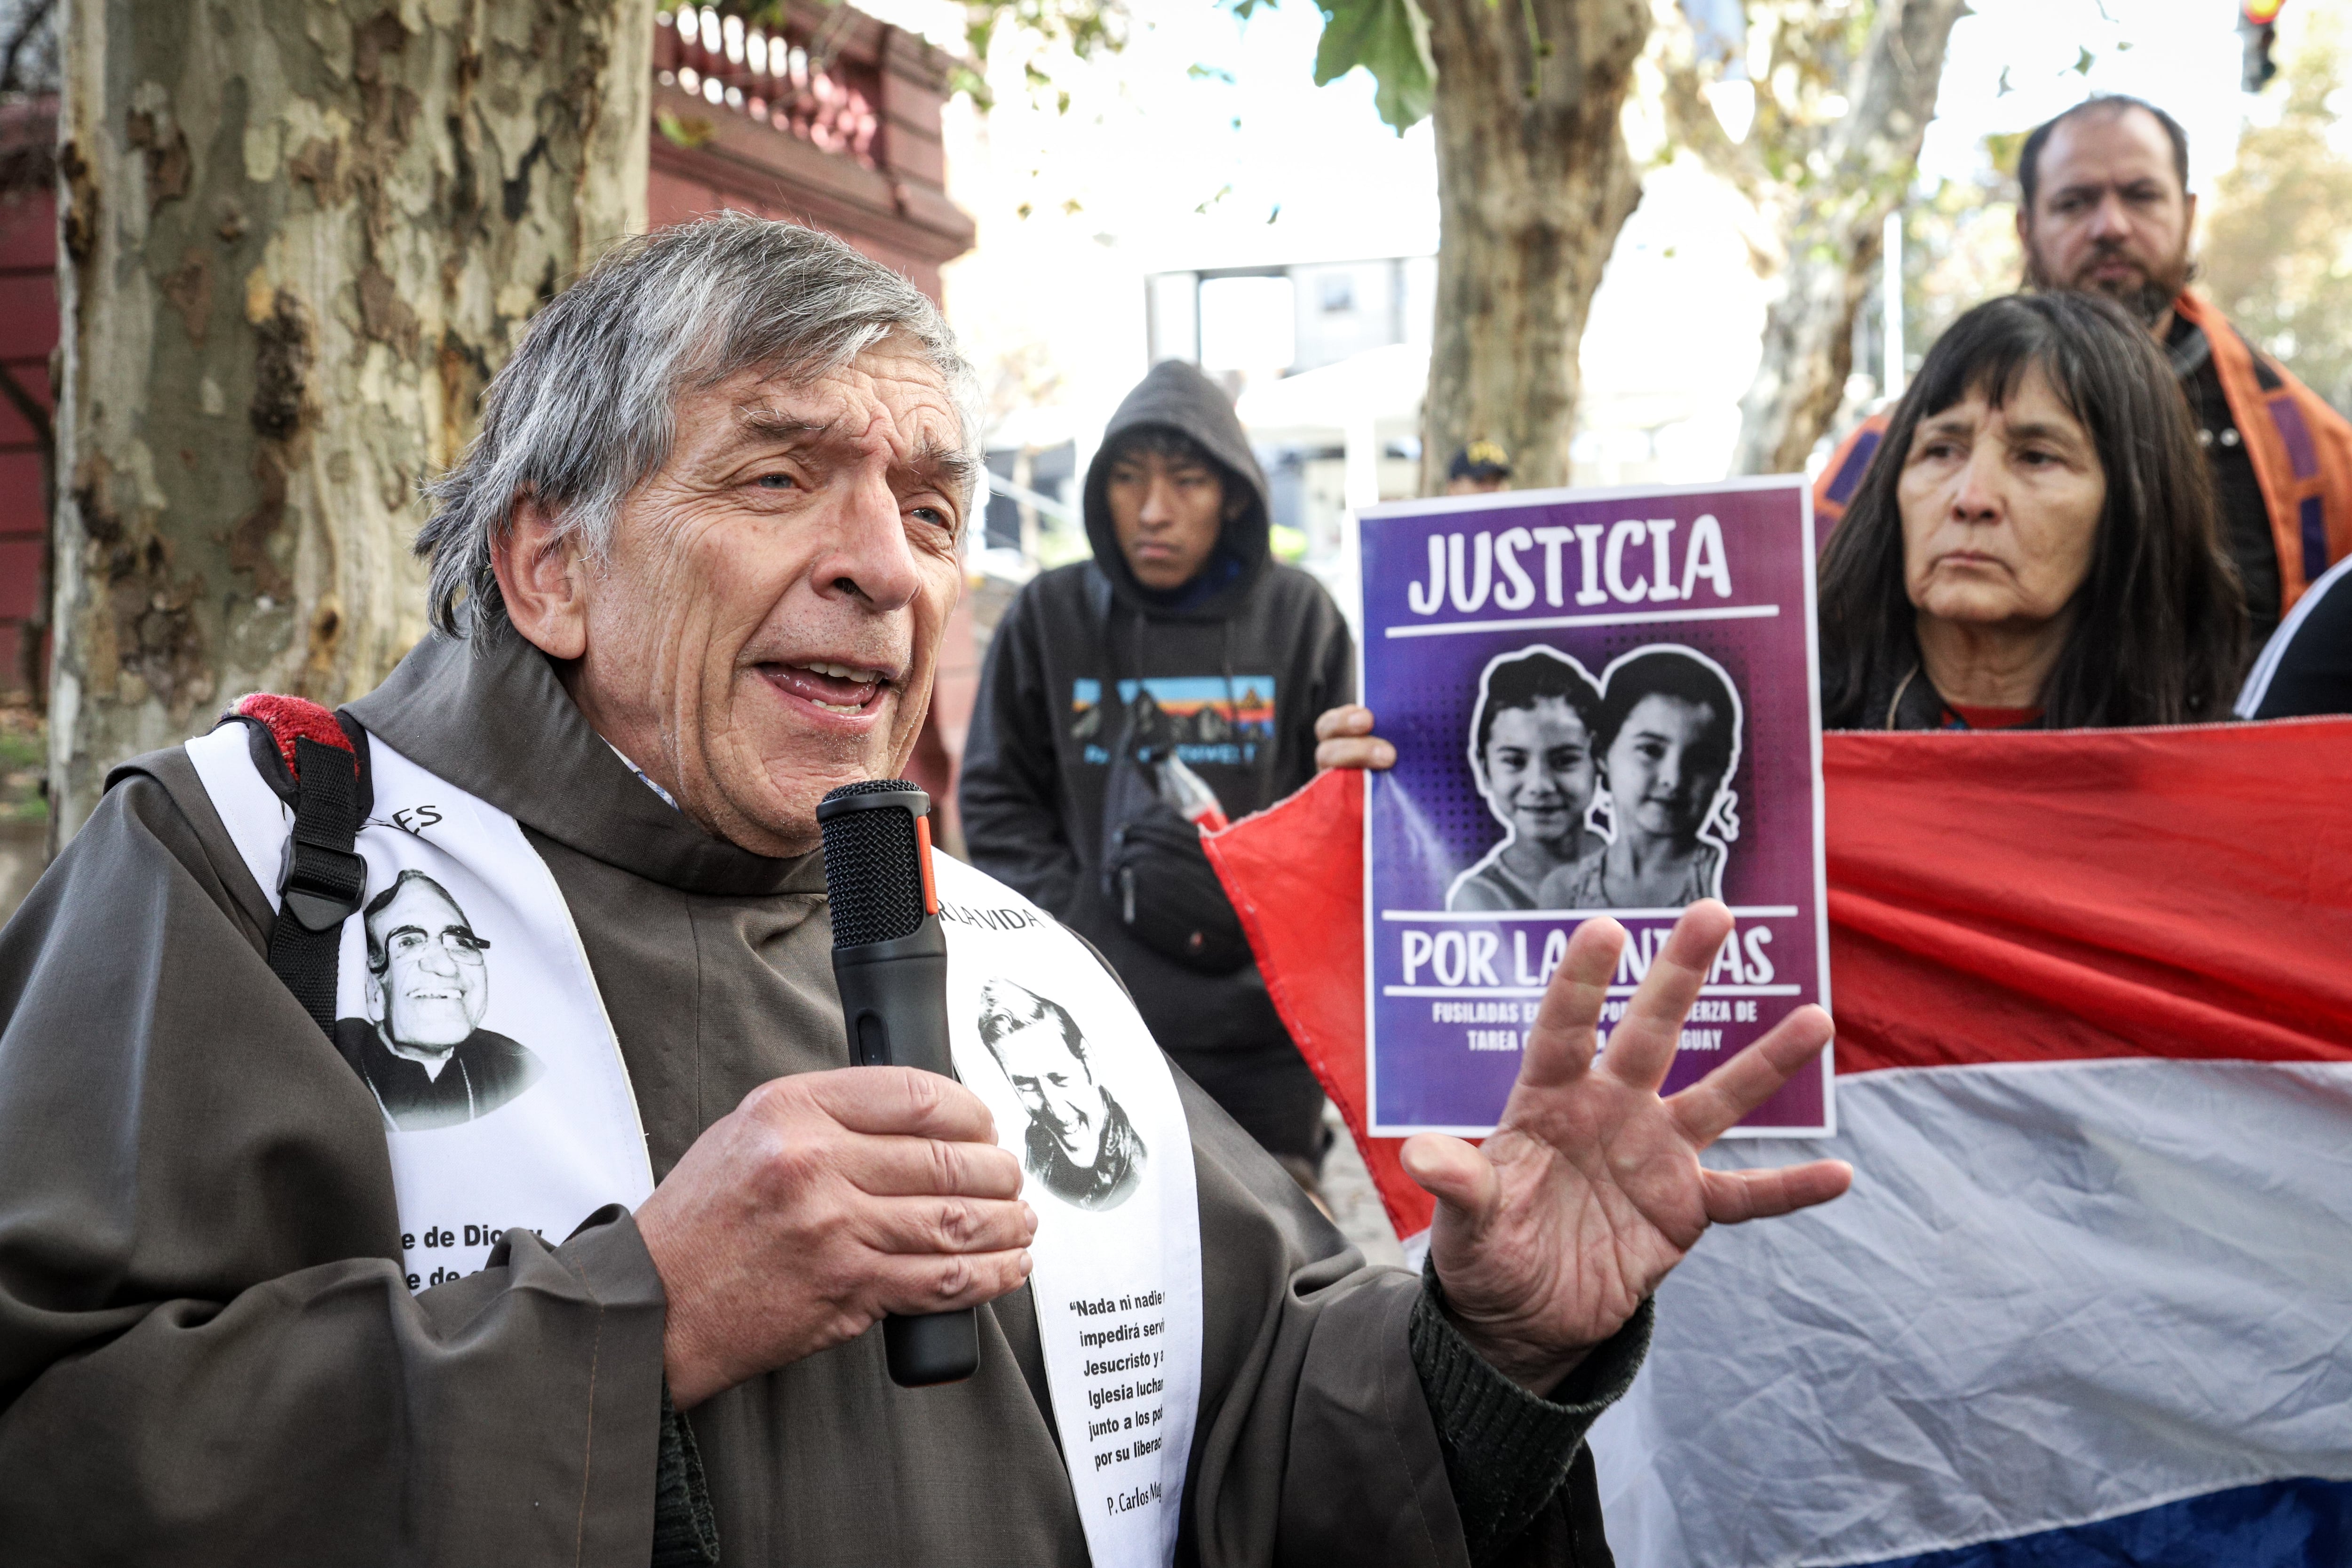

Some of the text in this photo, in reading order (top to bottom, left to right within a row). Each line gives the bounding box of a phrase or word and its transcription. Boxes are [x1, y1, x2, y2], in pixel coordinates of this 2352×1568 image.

[1408, 514, 1733, 615] JUSTICIA
[947, 901, 983, 929] LA
[973, 908, 1046, 930] VIDA
[1402, 930, 1501, 986] POR
[1514, 928, 1568, 986] LA
[1432, 1002, 1519, 1023] FUSILADAS
[1685, 1000, 1732, 1023] ERZA
[1735, 1000, 1758, 1023] DE
[1466, 1029, 1518, 1051] TAREA
[424, 1226, 455, 1248] de
[464, 1225, 503, 1246] Dio
[1120, 1294, 1132, 1311] ni
[1135, 1290, 1162, 1309] nadie
[1080, 1317, 1164, 1348] impedirá servi
[1083, 1351, 1150, 1377] Jesucristo
[1153, 1352, 1159, 1368] y
[1089, 1384, 1133, 1409] Iglesia
[1089, 1417, 1119, 1442] junto
[1124, 1417, 1132, 1430] a
[1136, 1411, 1150, 1427] los
[1095, 1432, 1161, 1472] por su liberac
[1107, 1497, 1118, 1516] P.
[1119, 1487, 1149, 1512] Carlos
